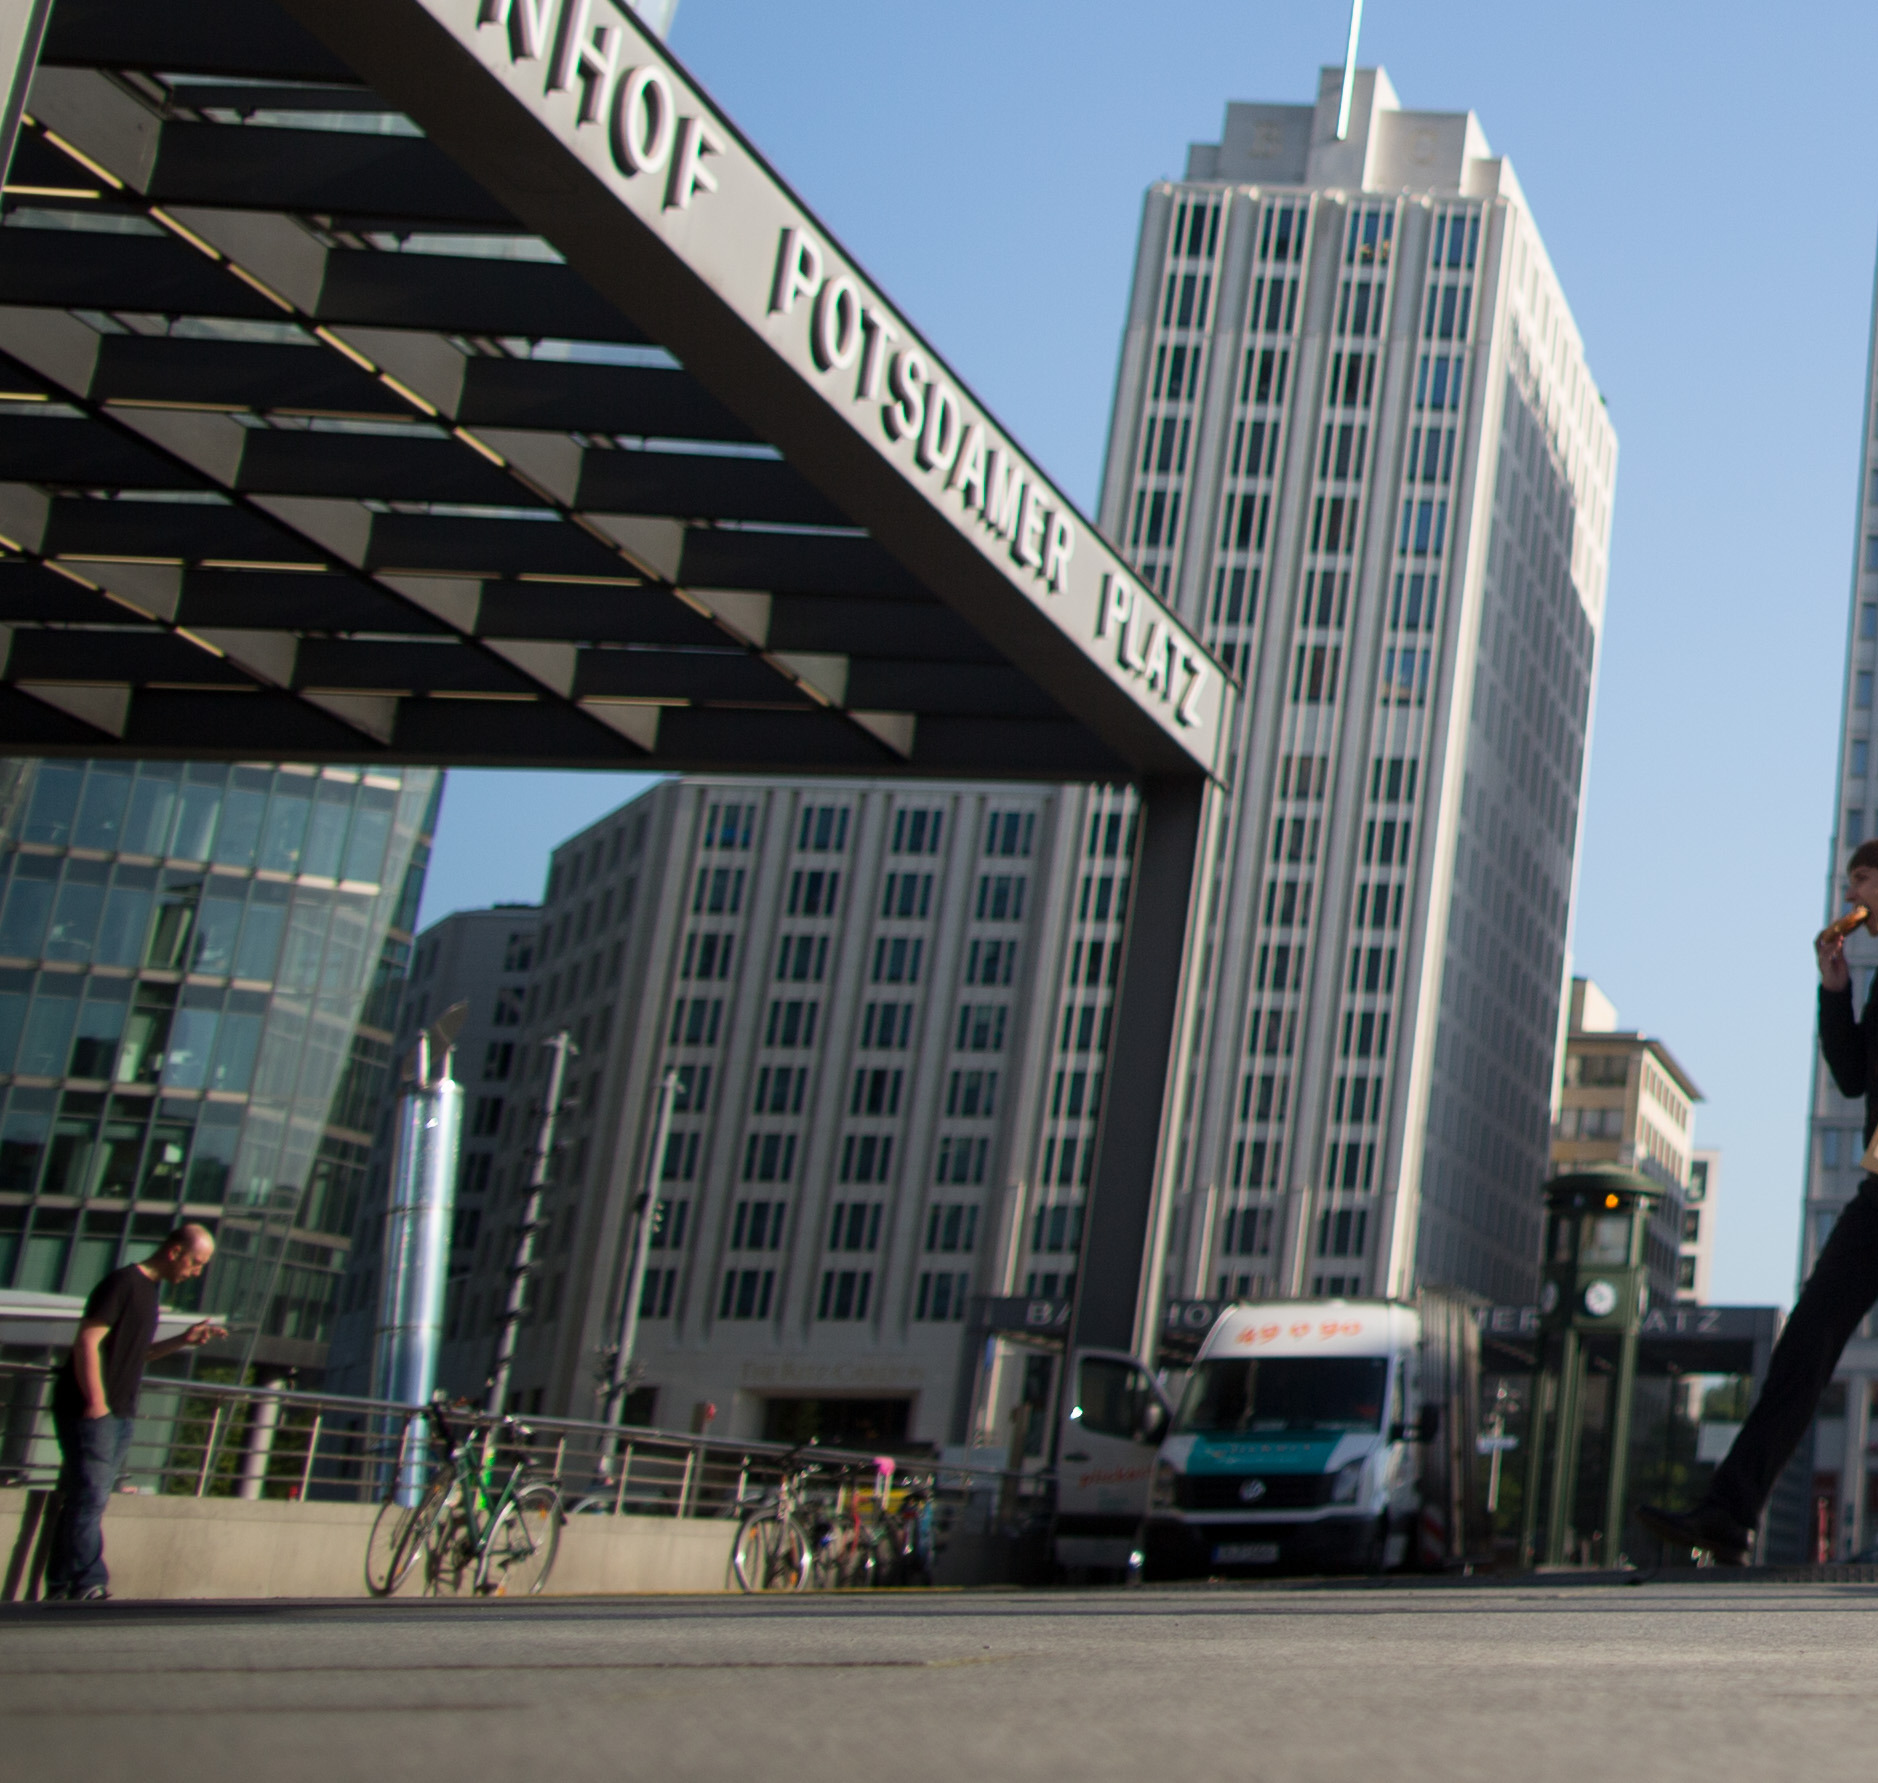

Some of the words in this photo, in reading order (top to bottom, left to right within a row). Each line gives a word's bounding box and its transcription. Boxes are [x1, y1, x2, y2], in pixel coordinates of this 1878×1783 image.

[768, 226, 1076, 595] POTSDAMER
[1096, 571, 1208, 728] PLATZ
[1642, 1309, 1724, 1334] ATZ
